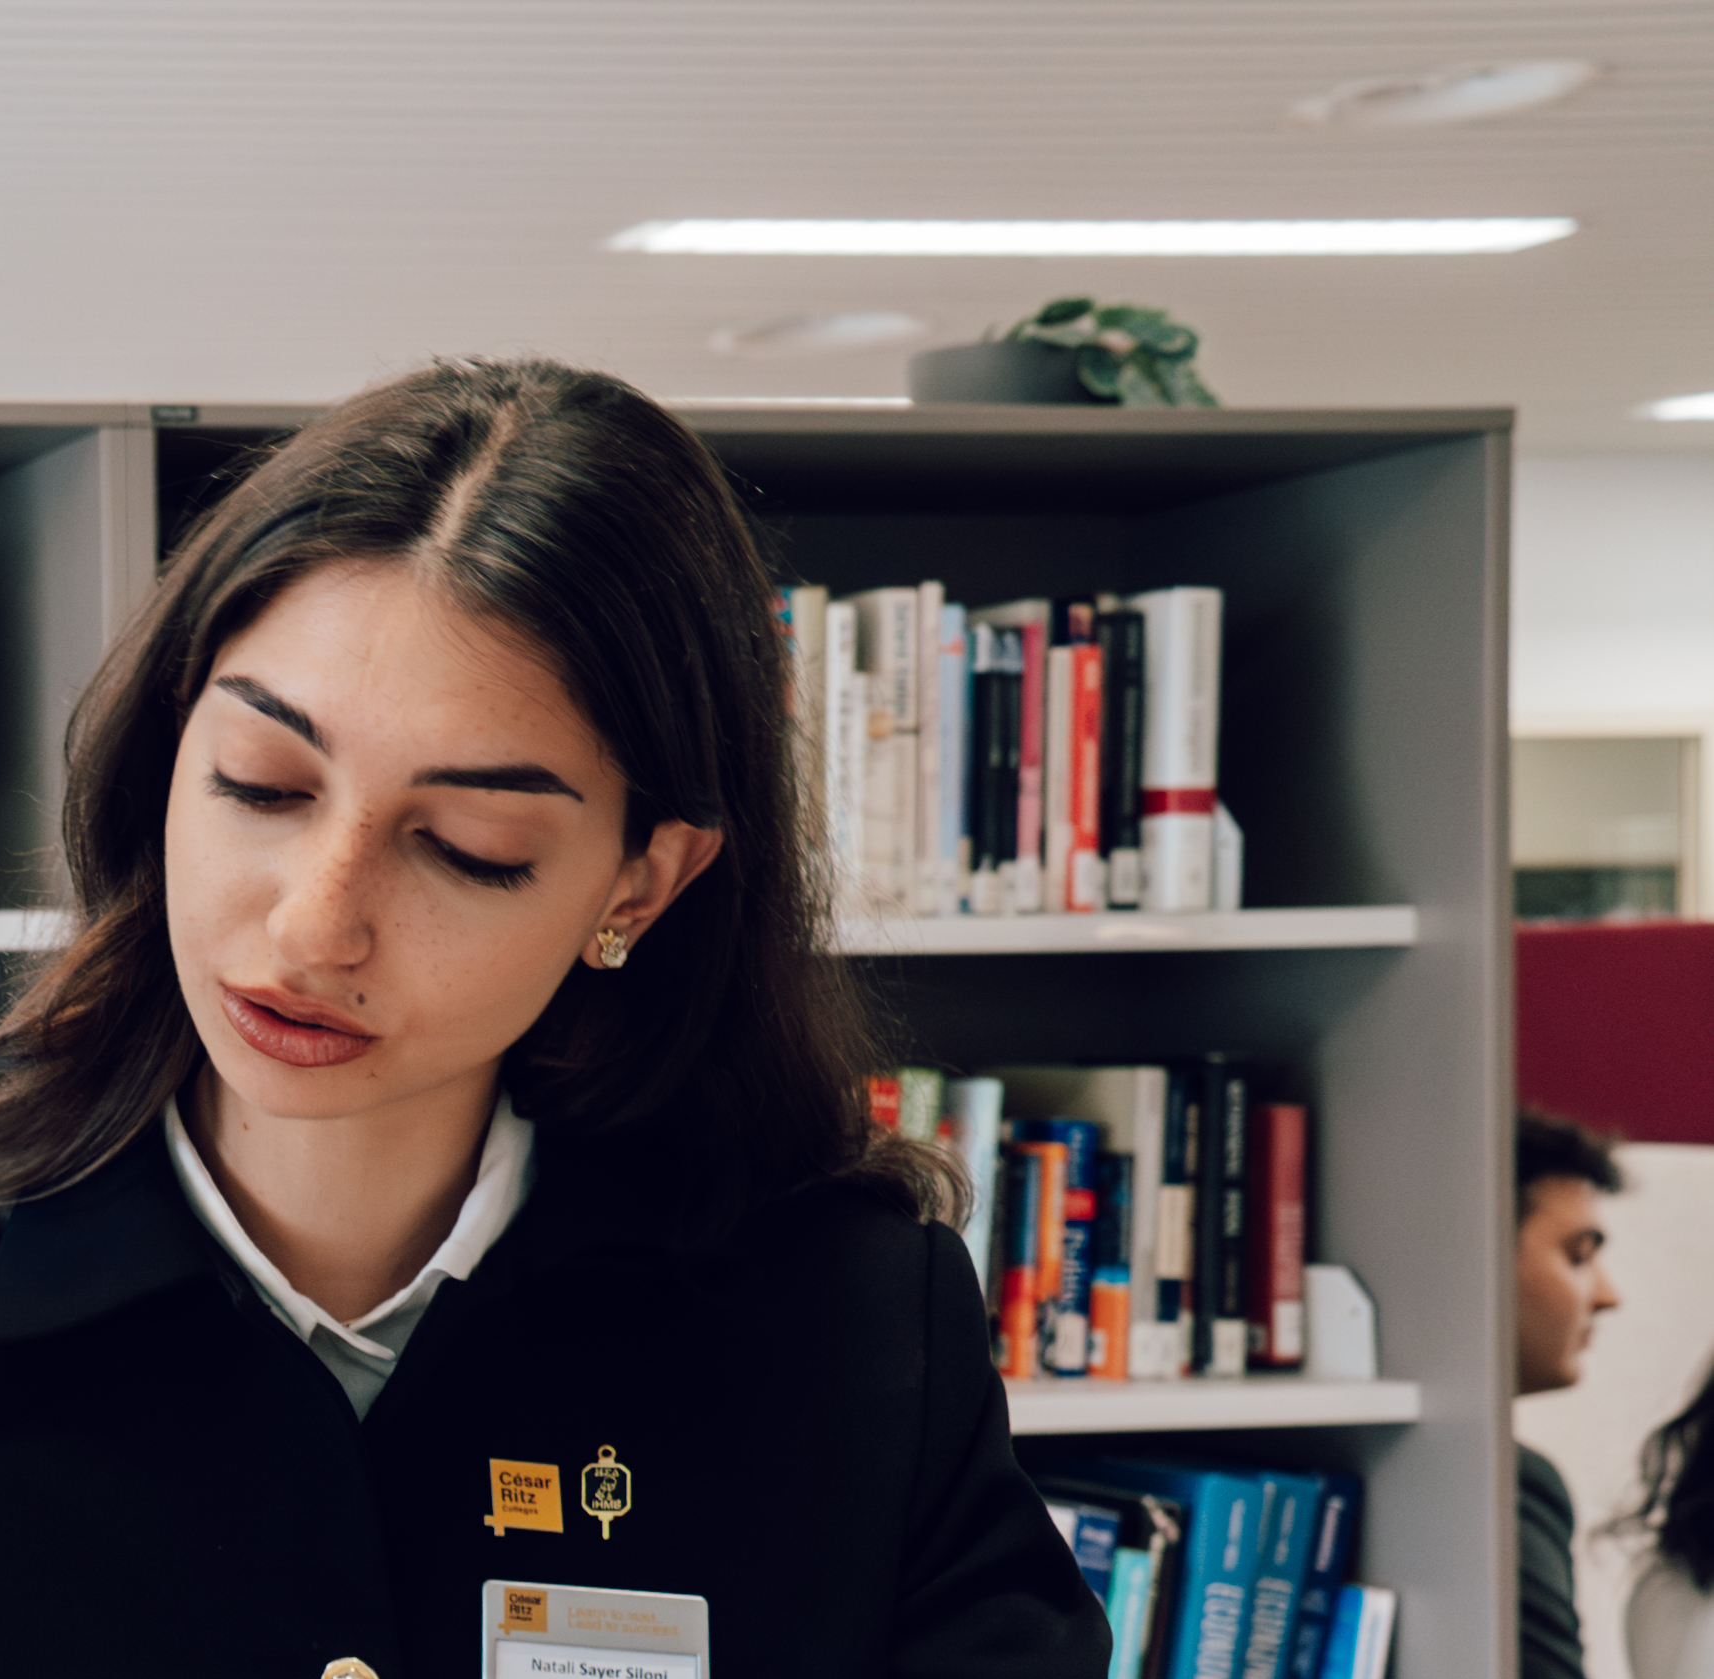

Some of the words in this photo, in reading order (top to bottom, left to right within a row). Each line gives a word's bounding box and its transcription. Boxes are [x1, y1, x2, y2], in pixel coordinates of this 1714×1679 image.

[499, 1471, 552, 1489] César
[501, 1487, 537, 1504] Ritz
[509, 1604, 532, 1615] Ritz
[531, 1658, 574, 1675] Natali
[579, 1663, 623, 1679] Sayer
